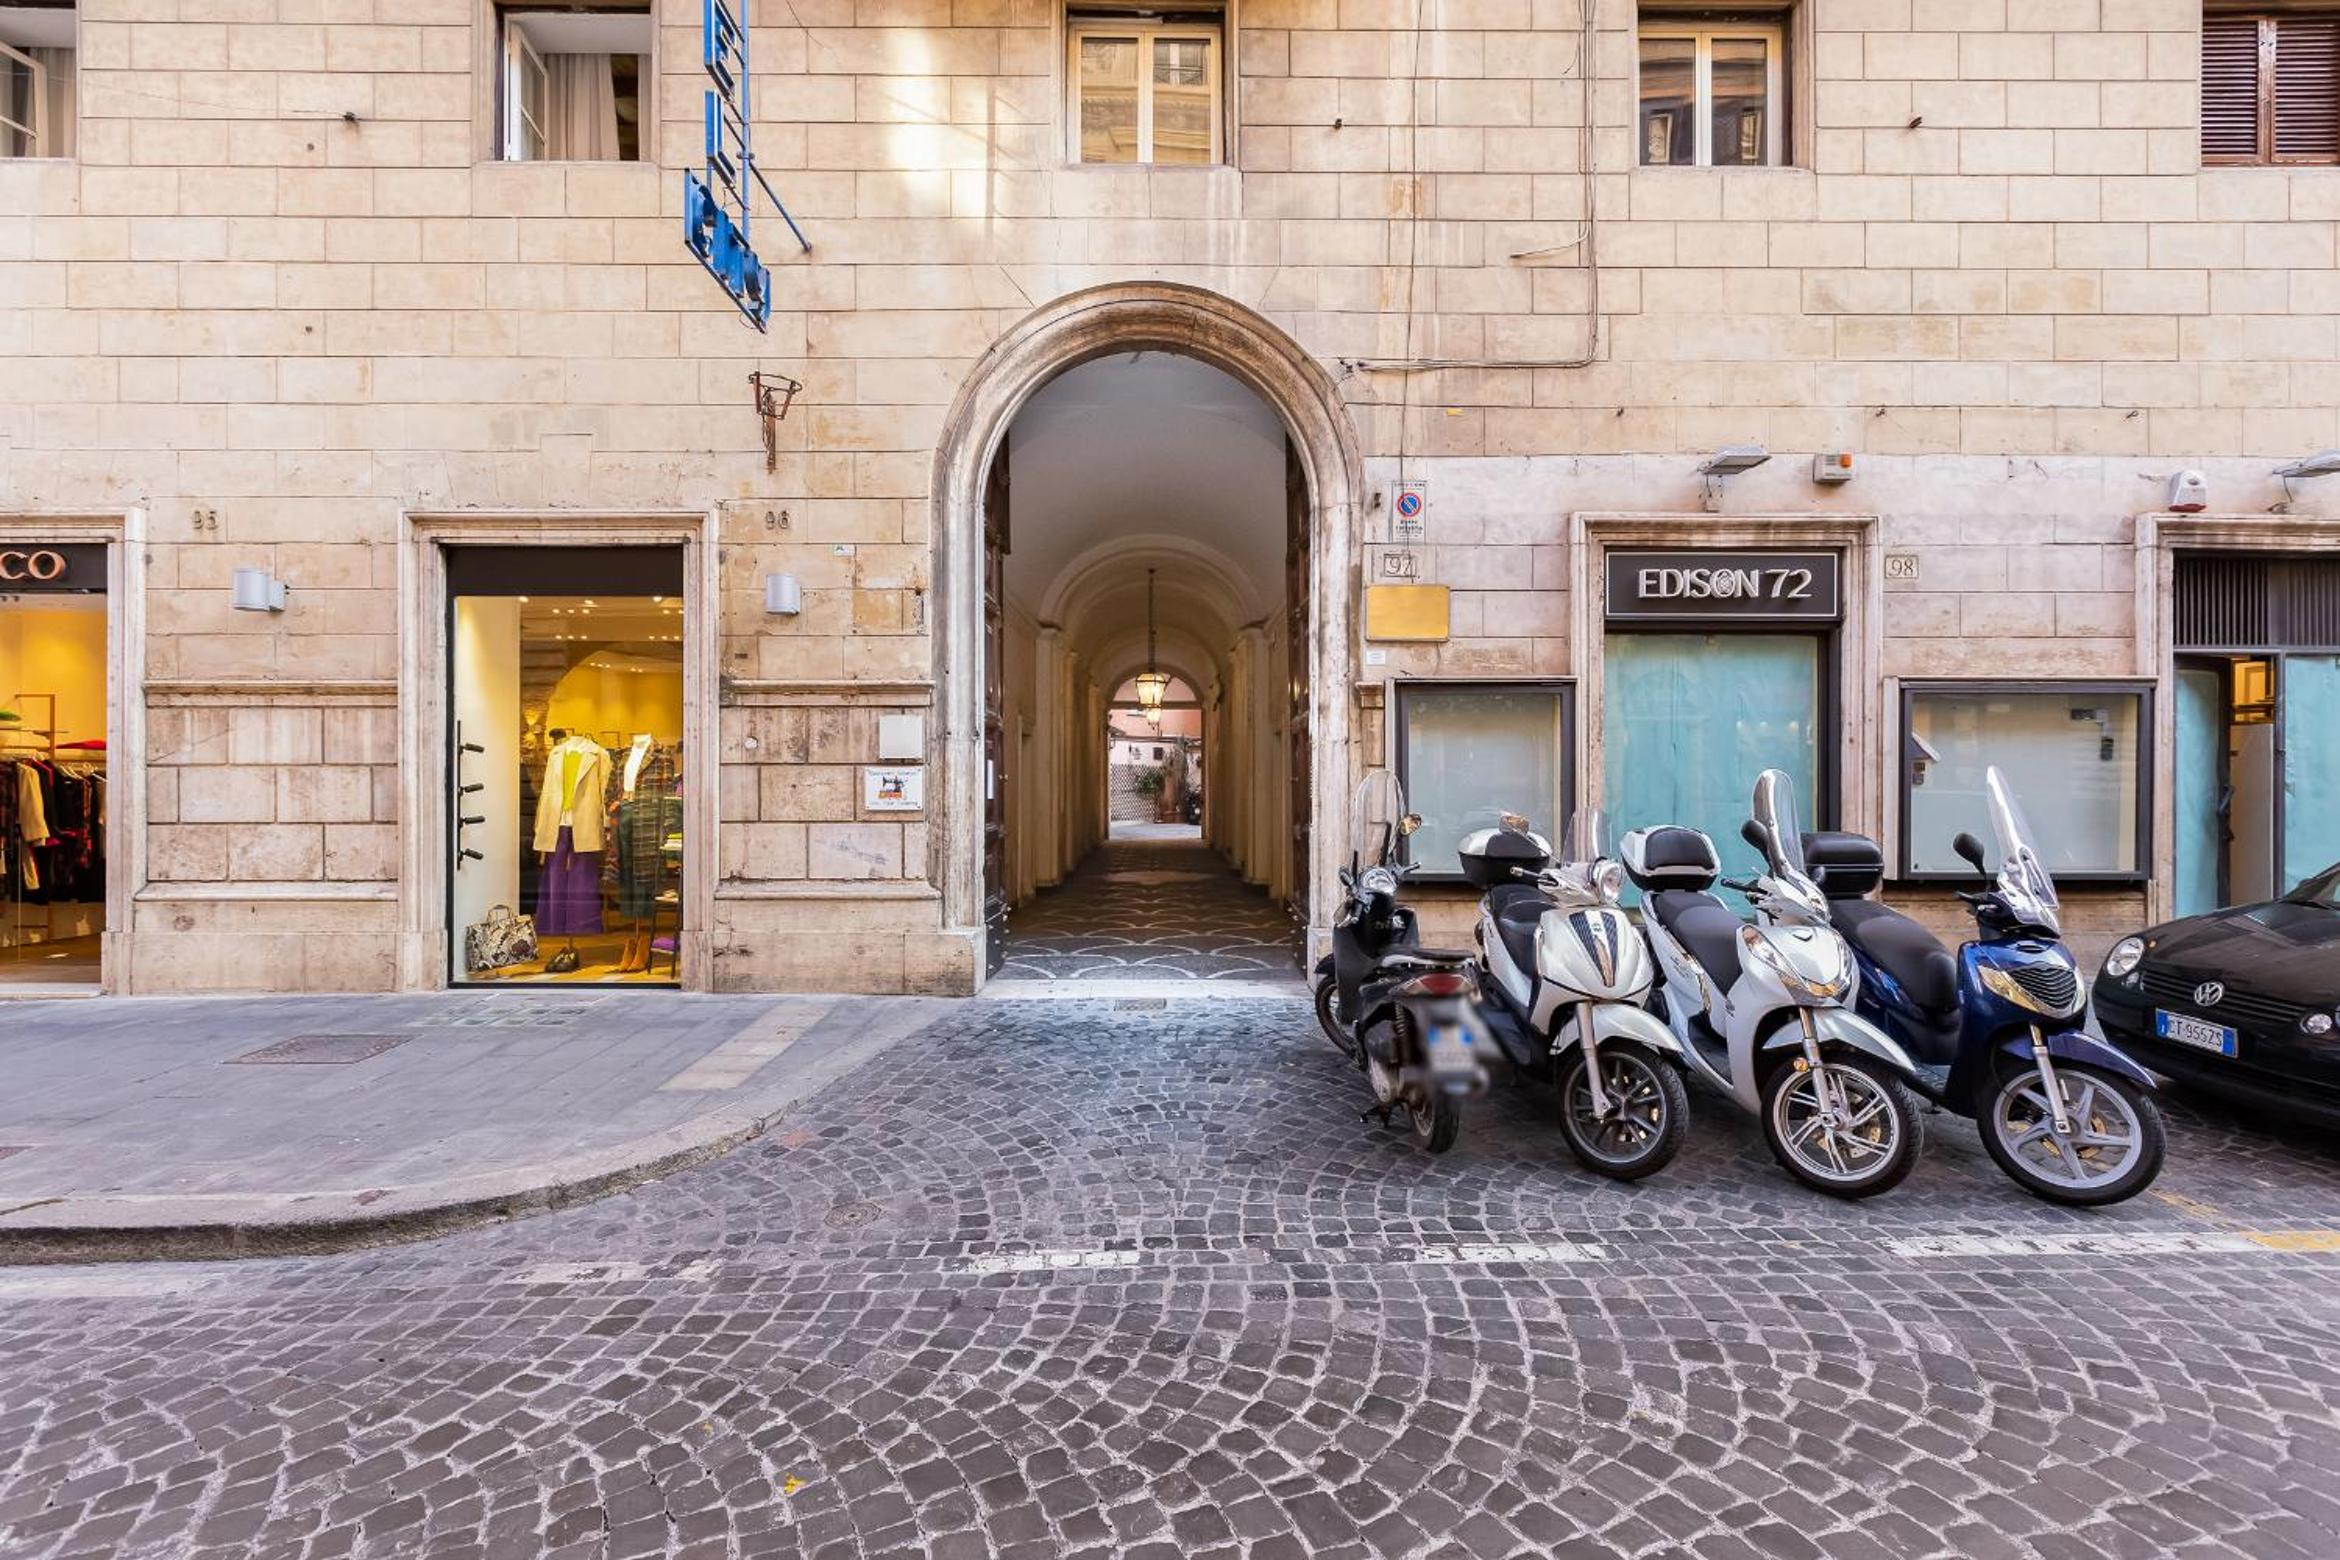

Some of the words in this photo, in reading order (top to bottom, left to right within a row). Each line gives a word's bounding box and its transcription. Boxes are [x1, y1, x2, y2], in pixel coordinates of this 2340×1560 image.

[191, 510, 218, 530] 95
[766, 510, 789, 530] 96
[1890, 558, 1914, 577] 98
[1638, 568, 1759, 598] EDISON
[1765, 568, 1812, 598] 72
